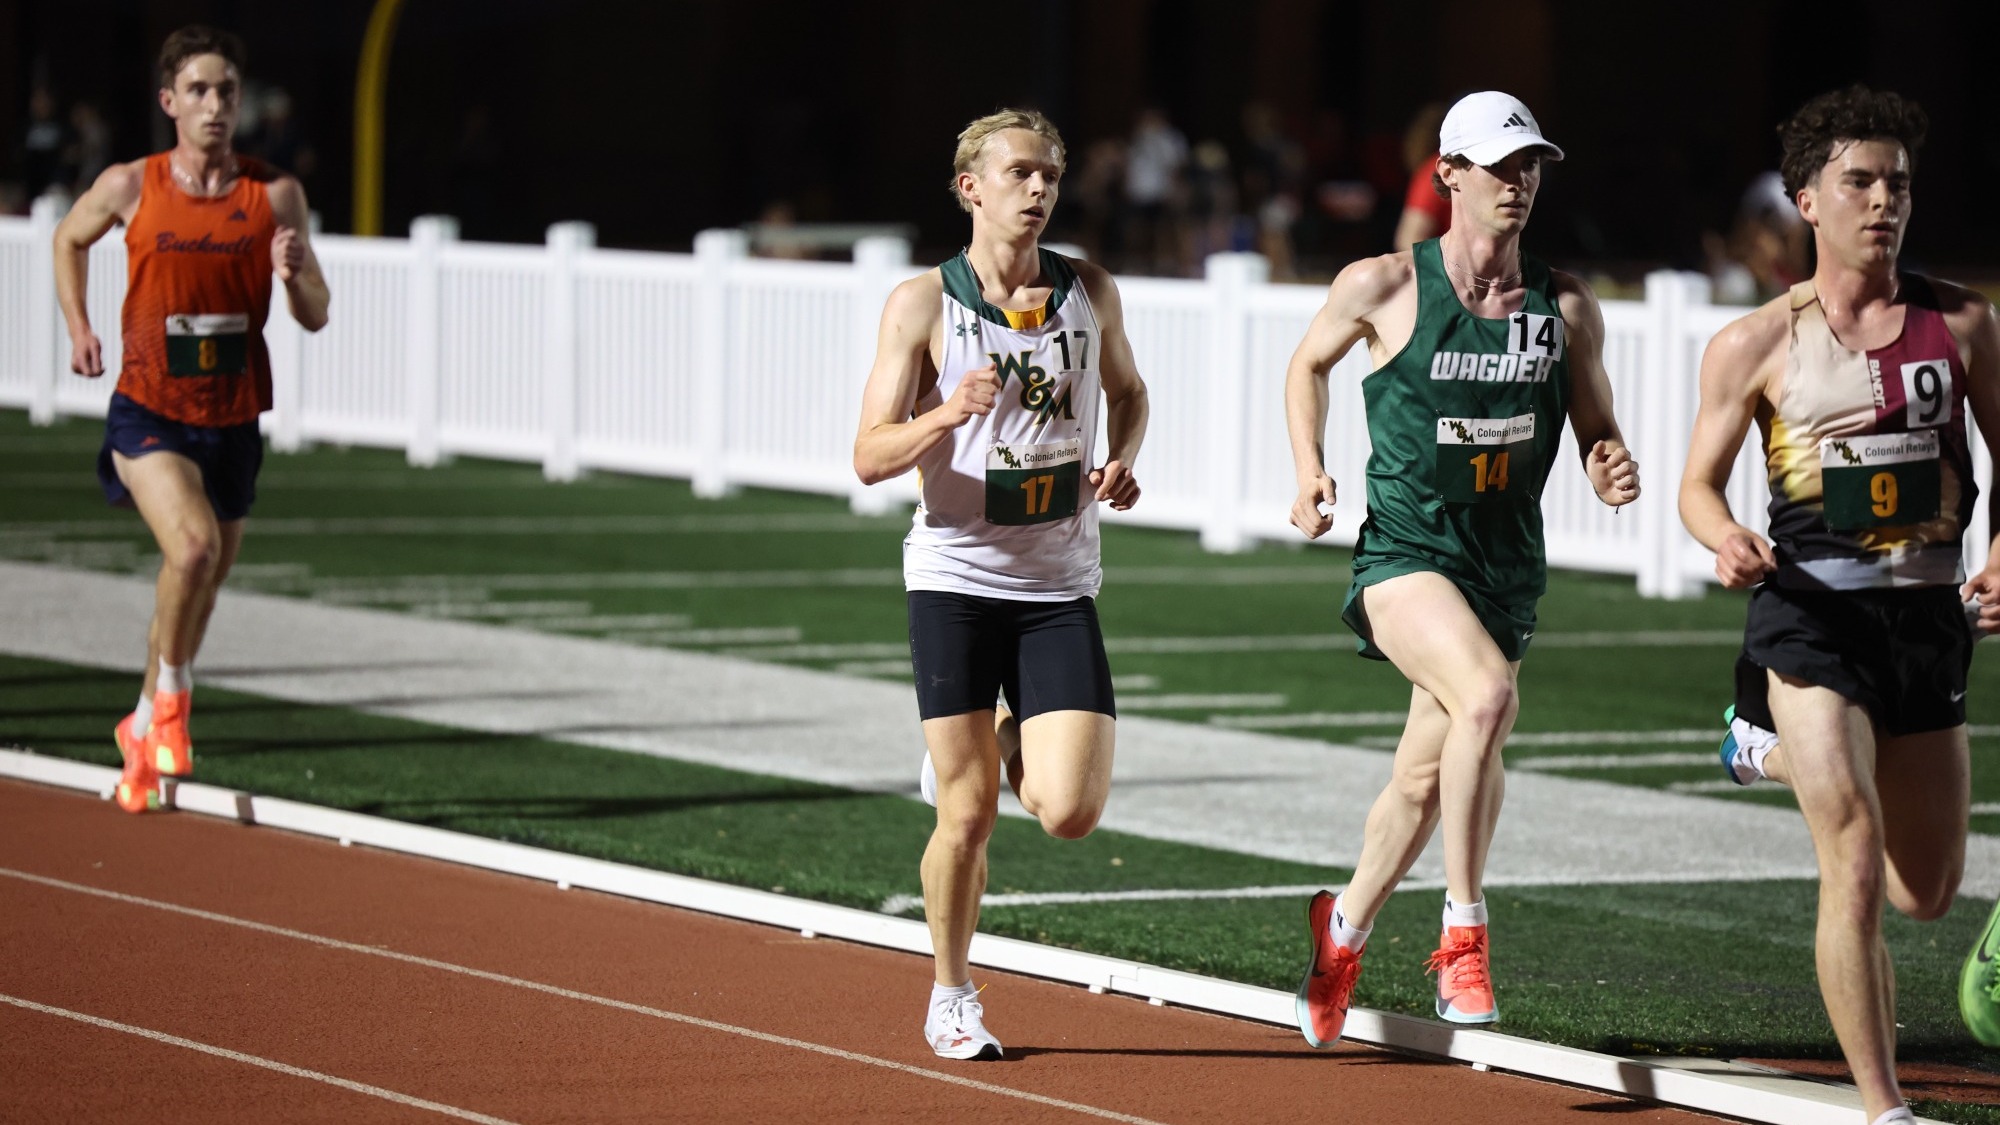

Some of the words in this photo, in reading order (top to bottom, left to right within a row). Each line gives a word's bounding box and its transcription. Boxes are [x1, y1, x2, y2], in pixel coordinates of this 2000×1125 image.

[156, 231, 254, 252] Bucknell
[199, 338, 217, 370] 8
[1053, 331, 1090, 370] 17
[1513, 313, 1557, 356] 14
[1430, 351, 1554, 383] WAGNER
[1868, 358, 1886, 409] BANDIT
[986, 350, 1076, 426] W&M
[1913, 364, 1943, 423] 9
[1449, 420, 1475, 444] W&M
[1477, 425, 1511, 438] Colonial
[1512, 423, 1532, 437] Relays
[997, 446, 1022, 469] W&M
[1024, 450, 1056, 463] Colonial
[1057, 446, 1078, 459] Relays
[1470, 452, 1509, 492] 14
[1832, 440, 1862, 465] W&M
[1865, 445, 1904, 458] Colonial
[1906, 441, 1936, 455] Relays
[1020, 475, 1054, 515] 17
[1870, 472, 1898, 518] 9
